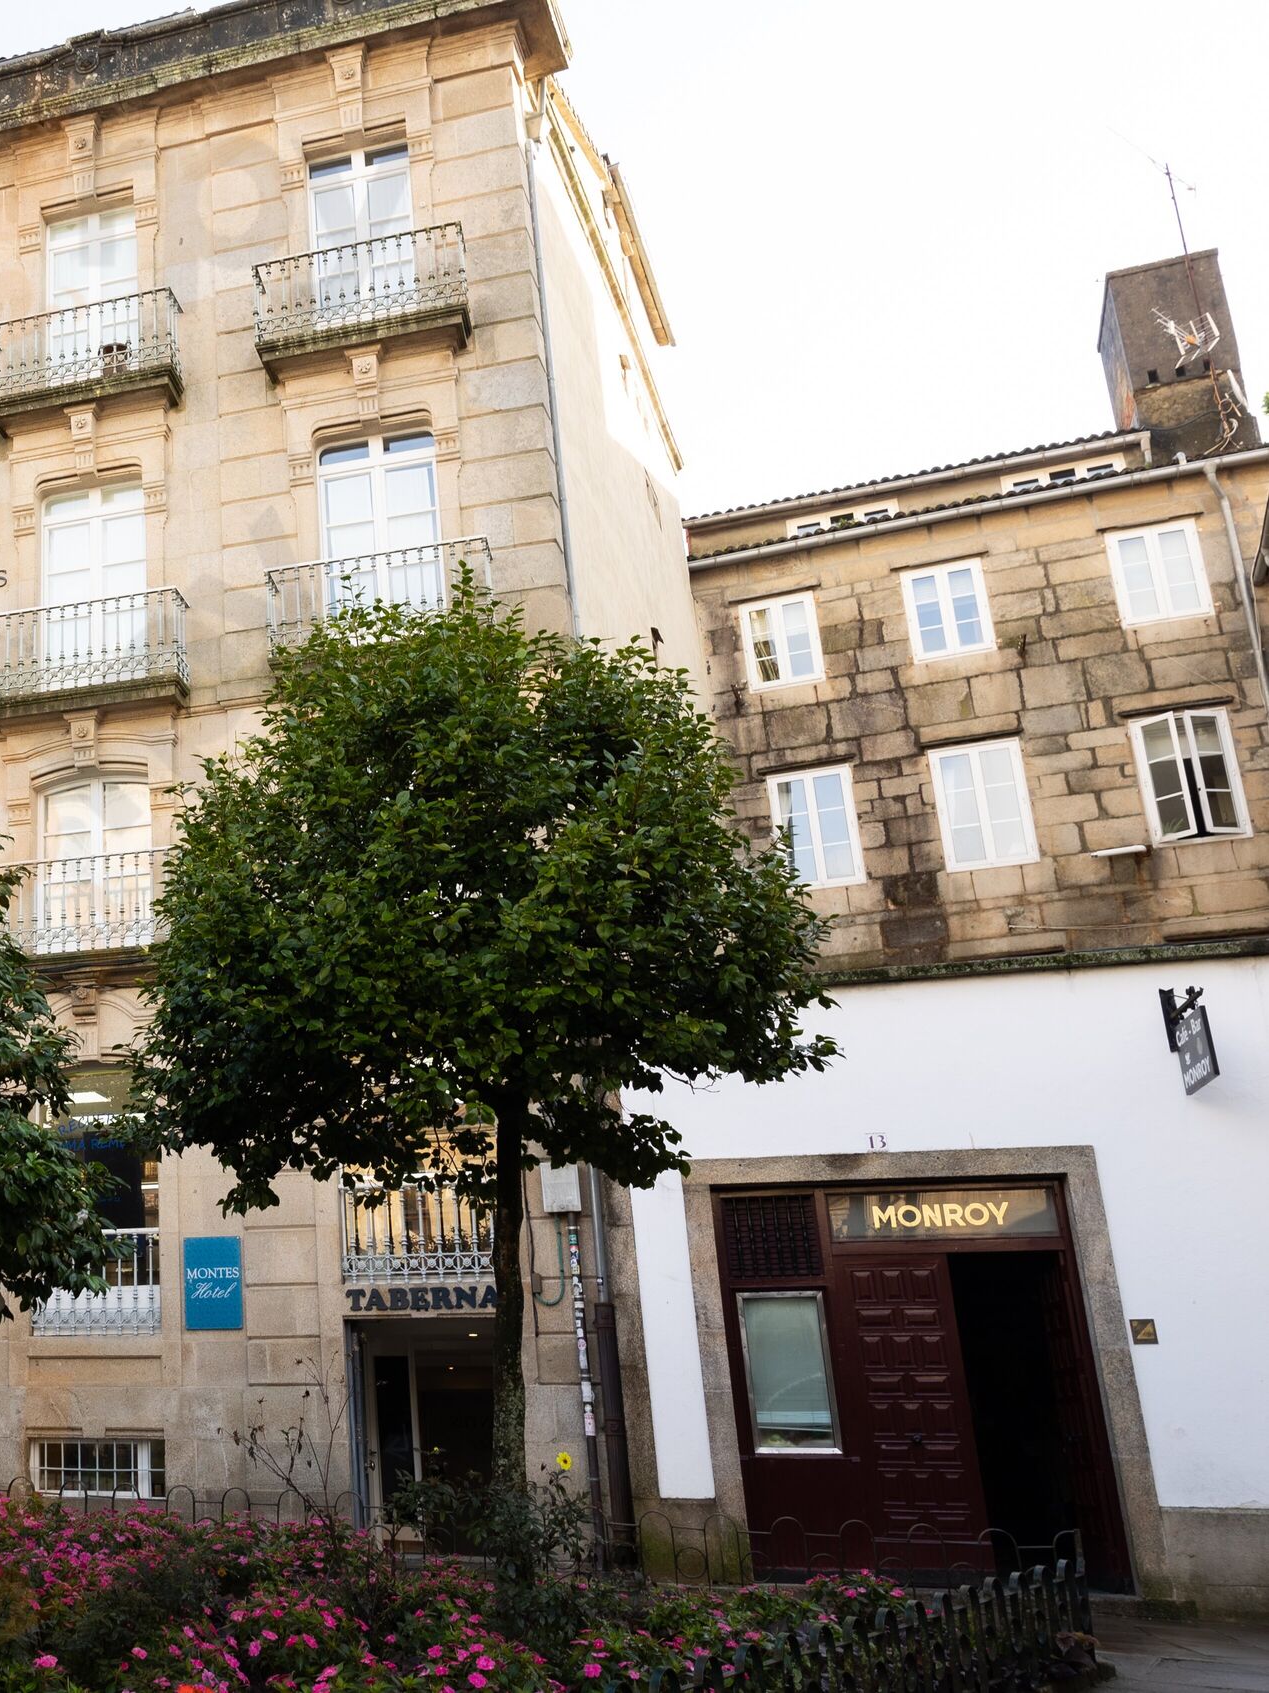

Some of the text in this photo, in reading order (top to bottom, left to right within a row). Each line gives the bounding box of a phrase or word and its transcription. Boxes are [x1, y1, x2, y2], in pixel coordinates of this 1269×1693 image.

[1183, 1056, 1210, 1089] MONROY
[869, 1135, 887, 1149] 13
[872, 1202, 1009, 1229] MONROY
[186, 1267, 240, 1280] MONTES
[191, 1282, 237, 1299] Hotel
[345, 1286, 498, 1312] TABERNA
